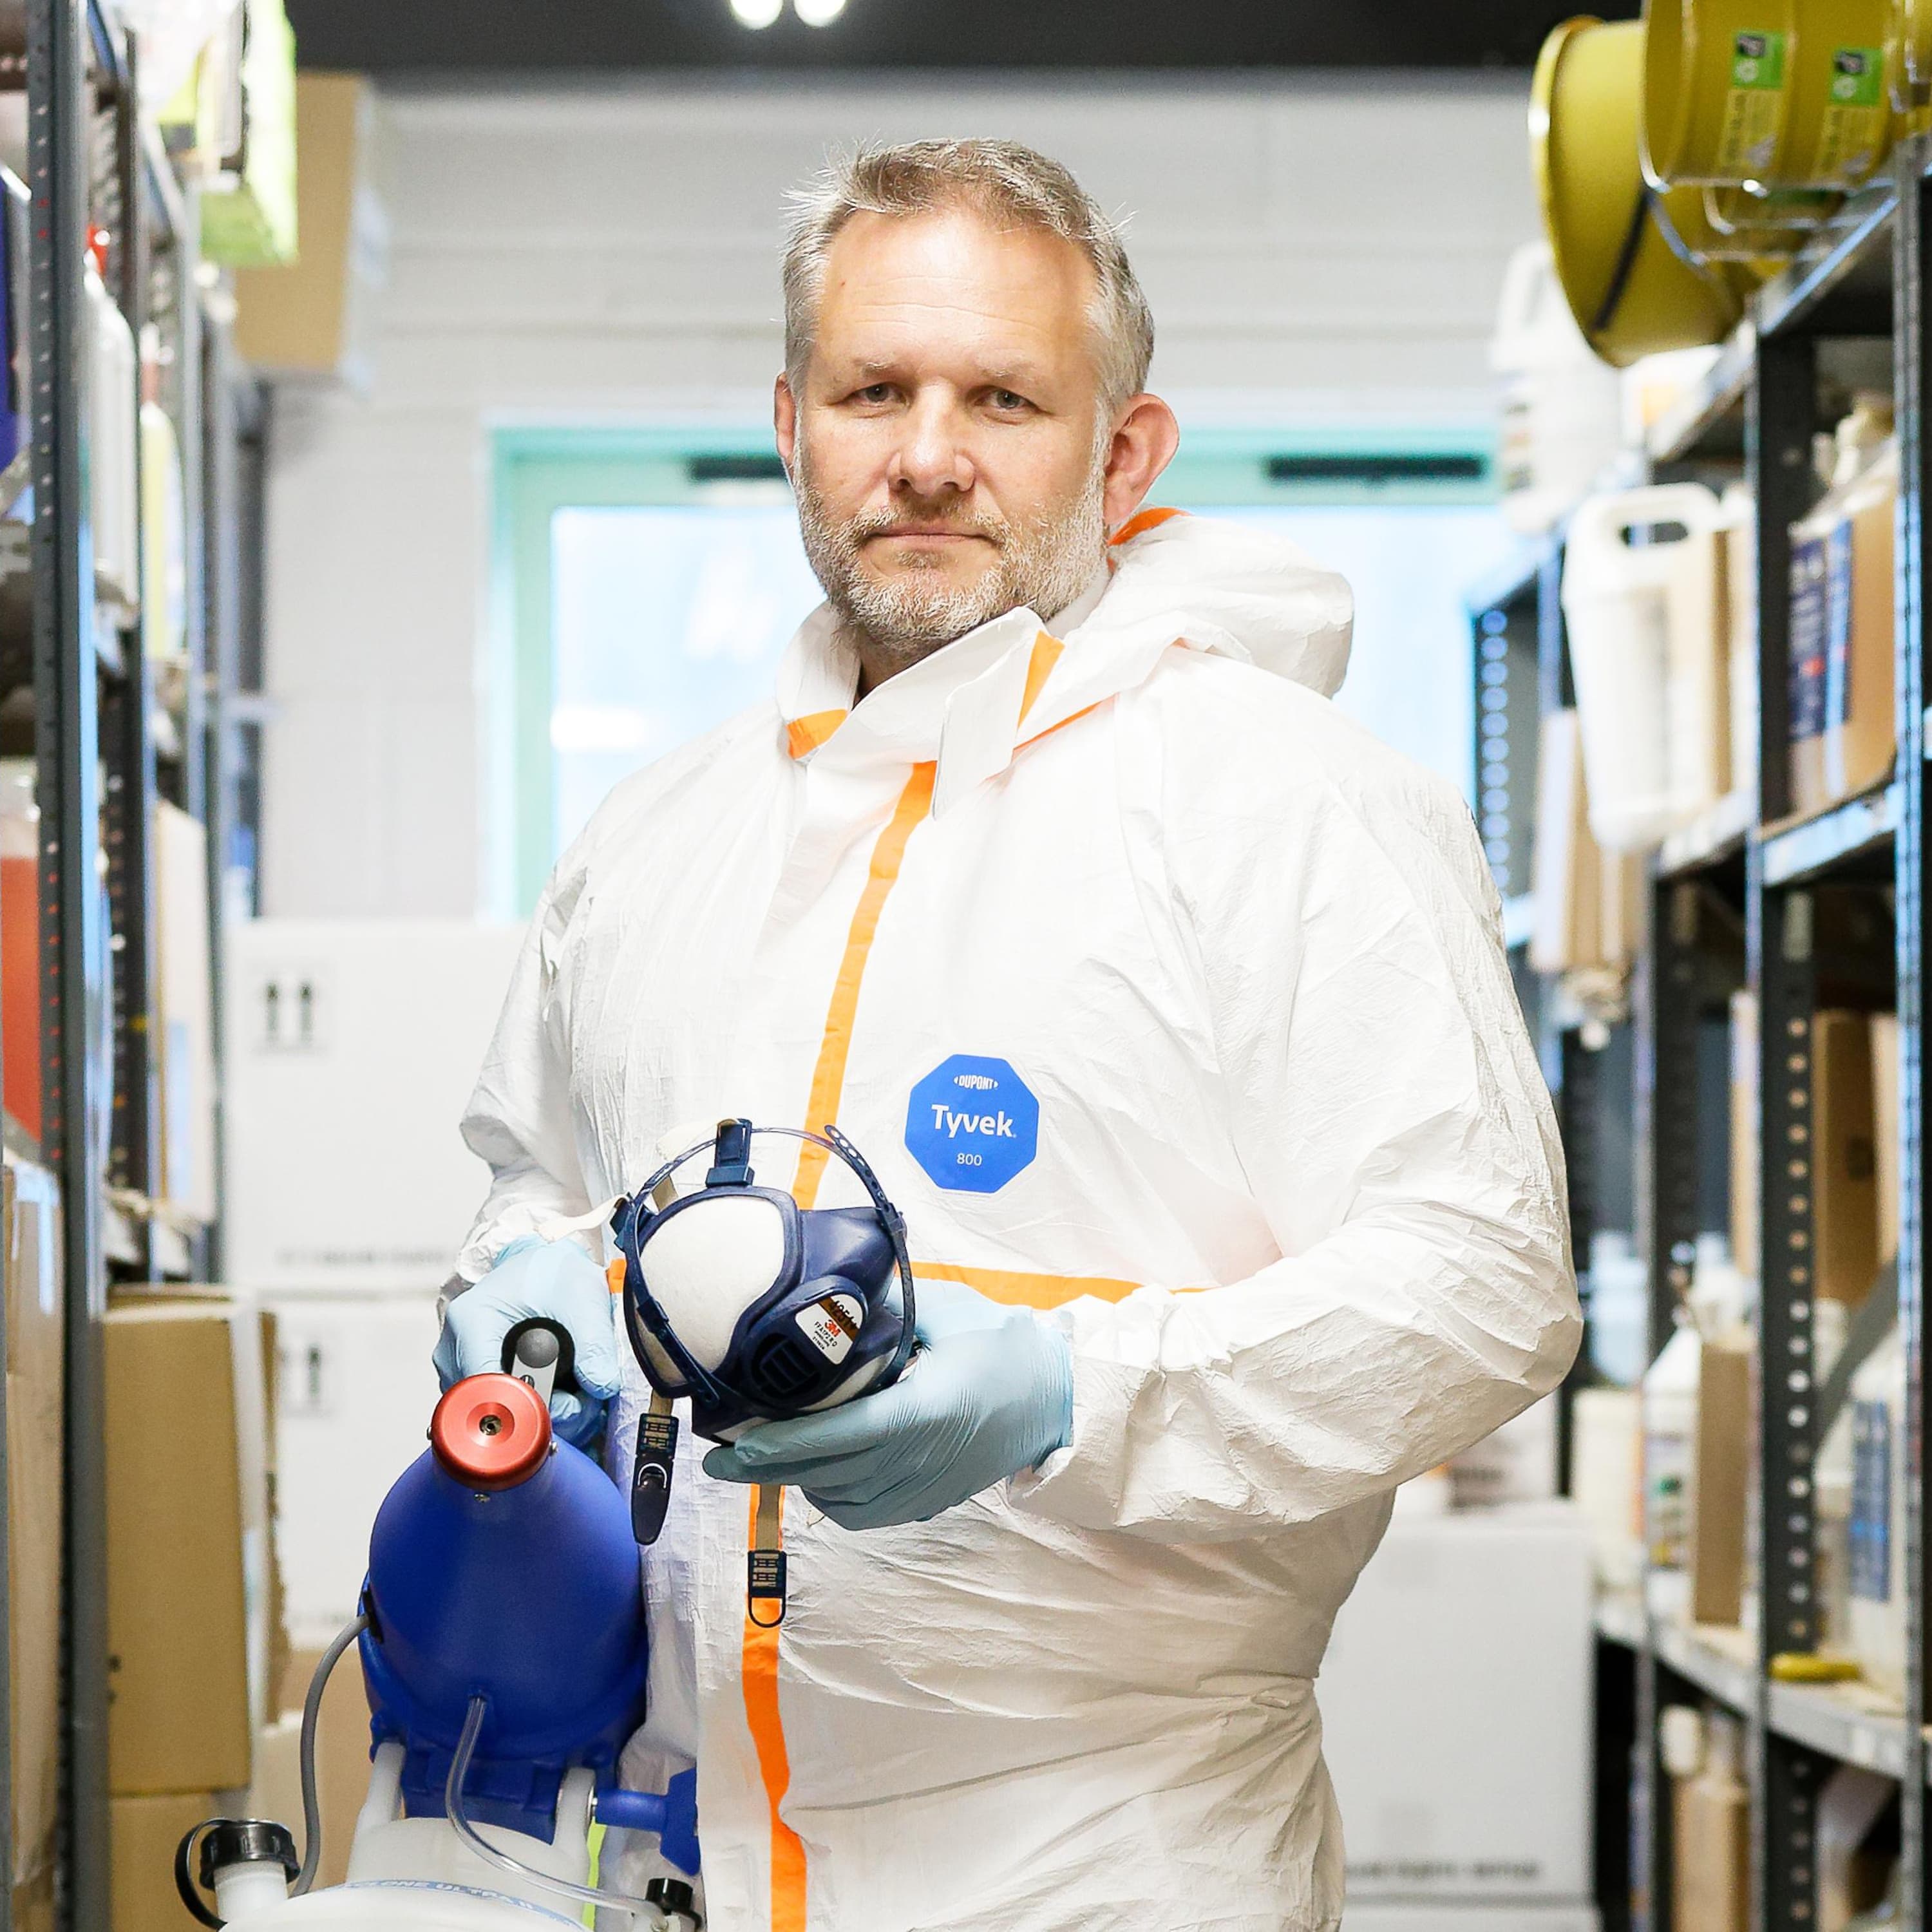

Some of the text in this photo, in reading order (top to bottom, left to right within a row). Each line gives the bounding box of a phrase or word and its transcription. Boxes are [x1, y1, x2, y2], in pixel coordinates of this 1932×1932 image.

[958, 1075, 994, 1090] DUPONT
[931, 1104, 1013, 1138] Tyvek
[957, 1153, 982, 1166] 800
[824, 1320, 841, 1337] 3M
